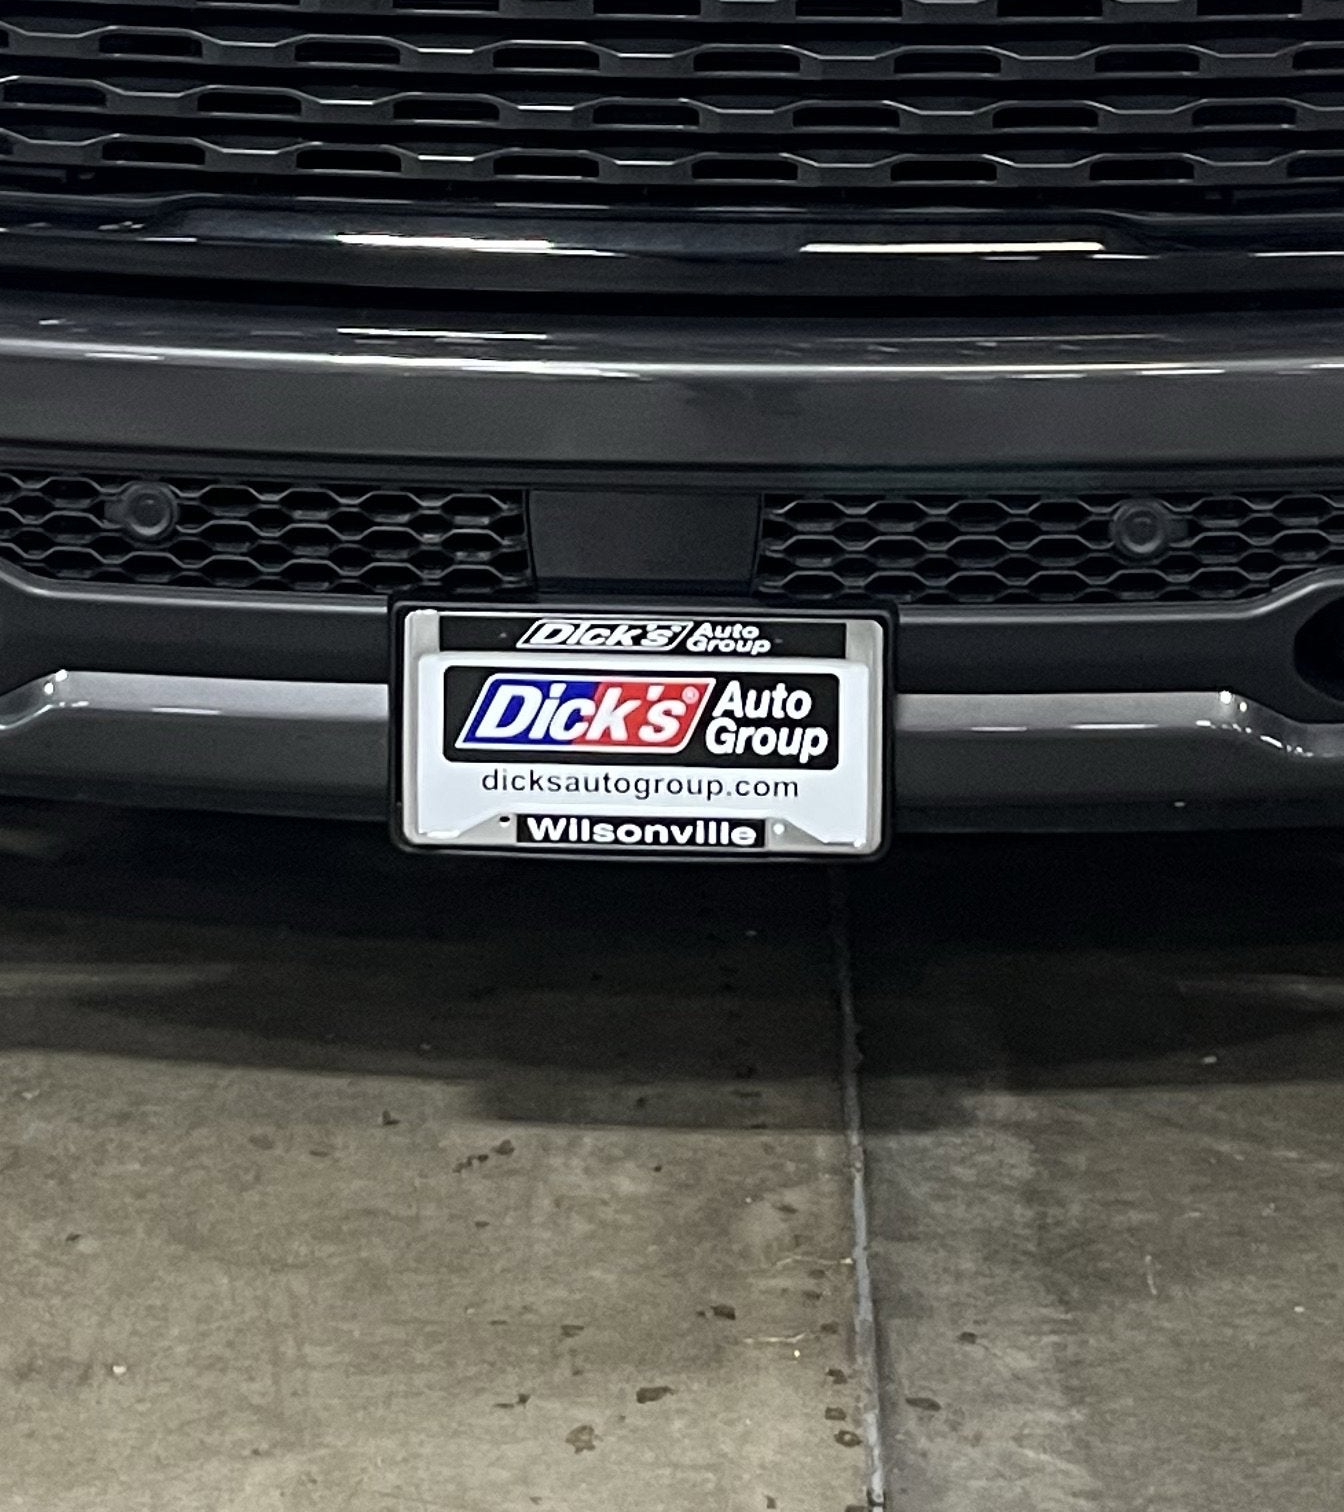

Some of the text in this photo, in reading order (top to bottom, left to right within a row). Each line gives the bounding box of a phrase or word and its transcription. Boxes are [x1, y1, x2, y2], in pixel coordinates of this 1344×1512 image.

[530, 623, 674, 647] Dick's
[686, 637, 771, 654] Group
[695, 623, 759, 639] Auto
[475, 682, 687, 743] Dick's
[712, 680, 812, 720] Auto
[706, 717, 829, 764] Group
[481, 769, 799, 801] dicksautogroup.com
[526, 817, 757, 846] Wilsonville
